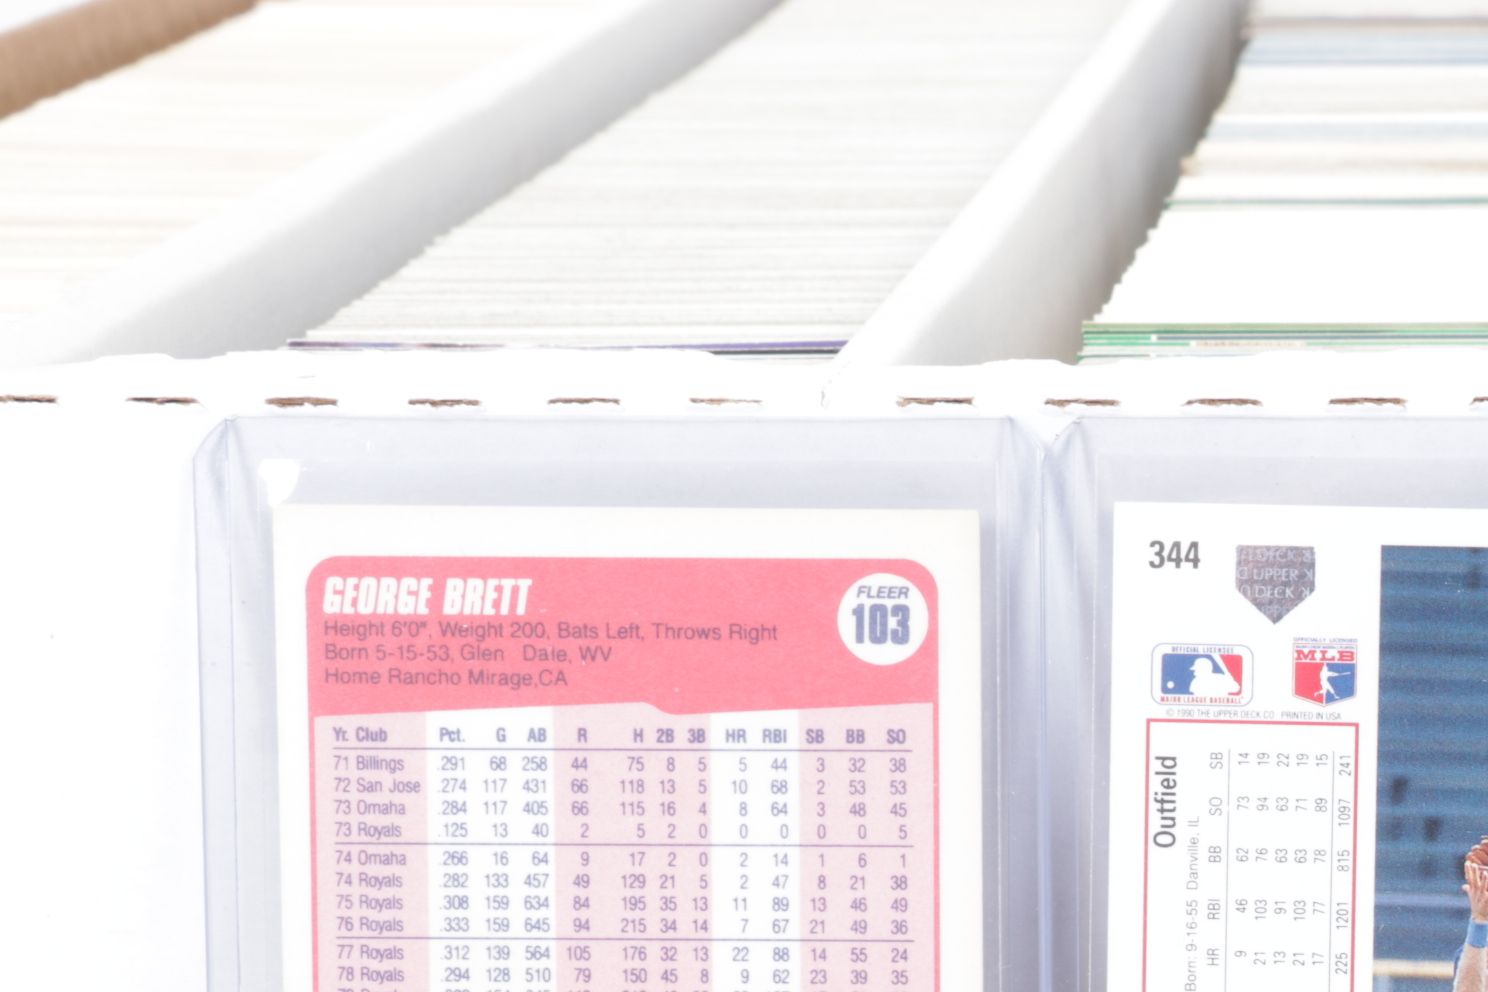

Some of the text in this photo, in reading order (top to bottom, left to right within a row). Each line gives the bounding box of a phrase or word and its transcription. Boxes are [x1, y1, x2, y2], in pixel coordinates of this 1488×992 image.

[1149, 541, 1200, 569] 344
[1253, 568, 1298, 581] UPPER
[322, 576, 532, 616] GEORGE BRETT
[857, 586, 909, 598] FLEER
[1256, 586, 1294, 598] DECK
[324, 620, 385, 640] Height
[440, 622, 503, 640] Weight
[558, 623, 598, 638] Bats
[606, 623, 644, 641] Left,
[651, 623, 722, 640] Throws
[729, 624, 778, 645] Right
[852, 603, 910, 645] 103
[324, 644, 368, 660] Born
[460, 645, 504, 661] Glen
[522, 646, 572, 664] Dale,
[579, 646, 612, 662] WV
[1295, 650, 1355, 661] MLB
[325, 668, 380, 684] Home
[388, 669, 461, 685] Rancho
[1197, 709, 1210, 718] THE
[1213, 710, 1238, 718] UPPER
[1240, 710, 1262, 718] DECK
[1281, 711, 1313, 719] PRINTED
[333, 728, 906, 744] Yr. Club Pct. G AB R H 2B 3B HR RBI SB BB SO
[1152, 756, 1178, 848] Outfield
[1188, 816, 1200, 827] IL
[1186, 899, 1199, 952] 9-16-55
[1185, 956, 1198, 992] Born:
